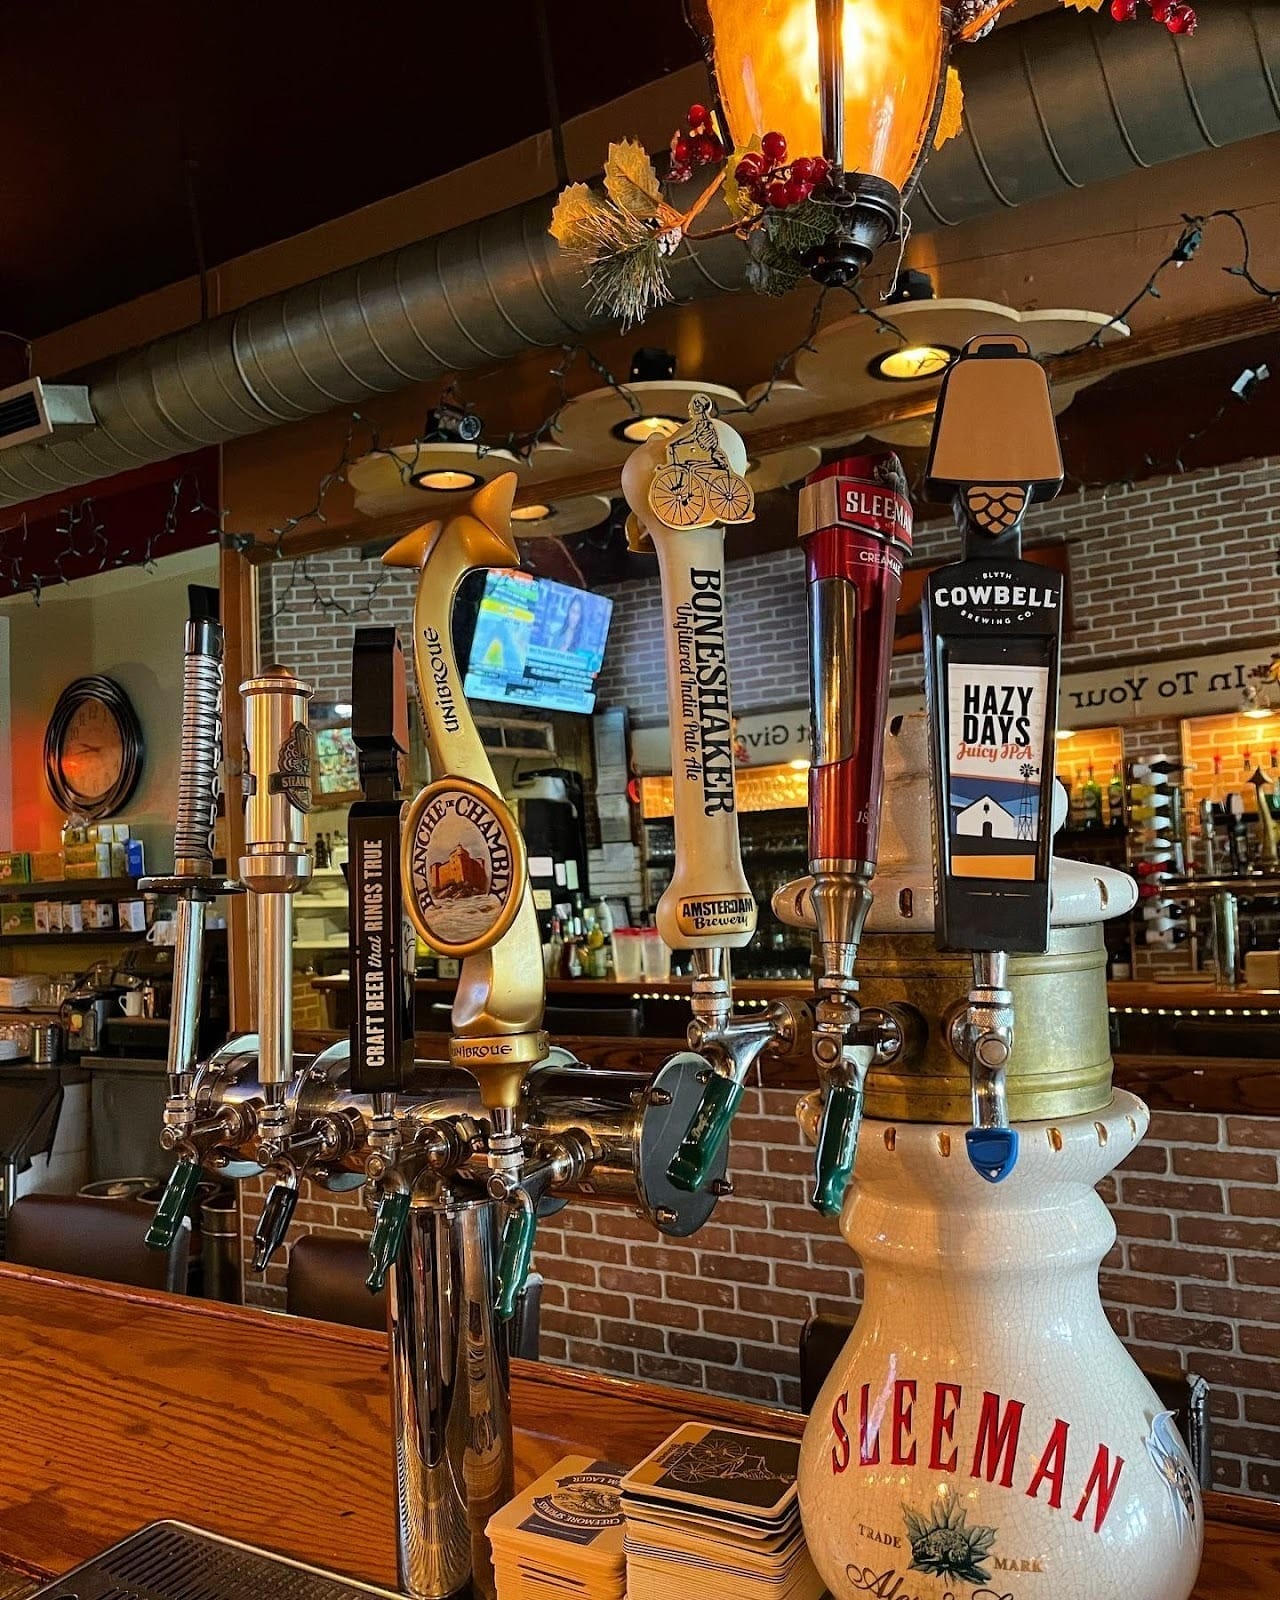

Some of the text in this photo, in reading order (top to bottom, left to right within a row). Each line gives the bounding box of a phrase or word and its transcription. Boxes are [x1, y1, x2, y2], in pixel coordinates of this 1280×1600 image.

[845, 490, 912, 538] SLEEMAN
[859, 551, 893, 569] CREAM
[982, 571, 1012, 580] BLYTH
[934, 585, 1057, 609] COWBELL
[960, 609, 1011, 625] BREWING
[673, 602, 702, 781] Unfiltered India Pale Ale
[690, 567, 735, 817] BONESHAKER
[963, 684, 1034, 717] HAZY
[963, 714, 1031, 747] DAYS
[207, 662, 225, 852] SAPPORO
[956, 741, 1034, 763] Juicy IPA
[414, 799, 447, 913] BLANCHE
[455, 795, 510, 906] CHAMBLY
[682, 898, 754, 918] AMSTERDAM
[693, 915, 748, 930] Brewery
[363, 839, 385, 1067] CRAFT BEER that RINGS TRUE
[831, 1379, 1125, 1534] SLEEMAN
[858, 1523, 1046, 1573] TRADE MARK
